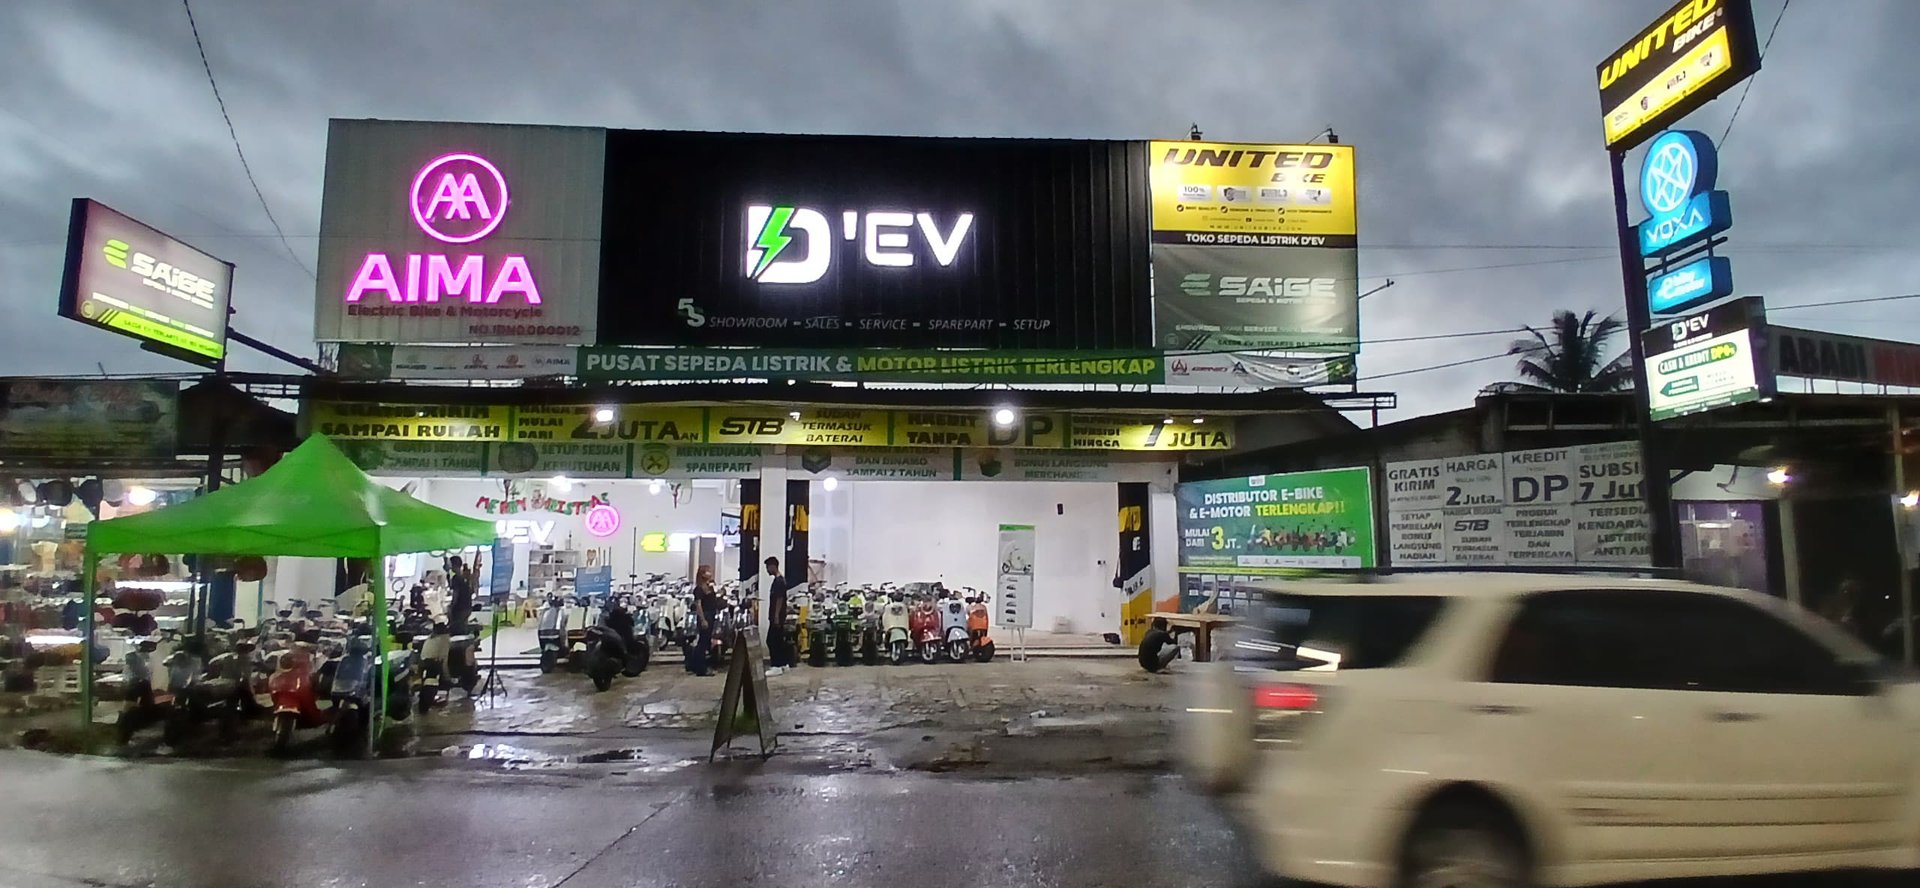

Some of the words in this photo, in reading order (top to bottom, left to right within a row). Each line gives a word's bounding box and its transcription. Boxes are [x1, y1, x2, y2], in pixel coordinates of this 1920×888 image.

[1672, 14, 1716, 54] BIKE
[1164, 148, 1333, 169] UNITED
[1271, 173, 1326, 184] BKE
[1186, 233, 1215, 244] TOKO
[1217, 234, 1259, 245] SEPEDA
[1261, 235, 1299, 246] LISTRIK
[1301, 236, 1326, 246] D'EV
[346, 253, 542, 304] AIMA
[348, 304, 403, 317] Electric
[409, 304, 440, 317] Bike
[446, 305, 456, 316] &
[461, 306, 543, 320] Motorcycle
[709, 316, 787, 328] SHOWROOM
[804, 318, 840, 329] SALES
[859, 318, 907, 330] SERVICE
[928, 319, 993, 331] SPAREPART
[1013, 319, 1051, 331] SETUP
[587, 354, 660, 371] PUSAT
[664, 355, 747, 371] SEPEDA
[752, 355, 832, 372] LISTRIK
[836, 356, 852, 372] &
[857, 356, 937, 373] MOTOR
[941, 357, 1017, 374] LISTRIK
[1022, 358, 1155, 375] TERLENGKAP
[518, 418, 563, 426] MULAI
[719, 416, 786, 436] STB
[801, 422, 872, 431] TERMASUK
[320, 422, 410, 437] SAMPAI
[417, 425, 500, 438] RUMAH
[518, 430, 553, 439] DARI
[806, 433, 863, 443] BATERAI
[907, 431, 972, 445] TANPA
[1167, 431, 1228, 447] JUTA
[582, 444, 624, 456] SESUAI
[1511, 450, 1568, 464] KREDIT
[686, 462, 753, 473] SPAREPART
[1446, 458, 1498, 473] HARGA
[1388, 465, 1440, 481] GRATIS
[1394, 479, 1436, 492] KIRIM
[1512, 474, 1569, 503] DP
[1579, 481, 1595, 501] 7
[1204, 490, 1277, 505] DISTRIBUTOR
[1281, 486, 1324, 500] E-BIKE
[1446, 486, 1462, 506] 2
[1189, 509, 1198, 519] &
[1199, 505, 1251, 519] E-MOTOR
[1255, 500, 1346, 517] TERLENGKAP!!
[1515, 509, 1558, 517] PRODUK
[1400, 512, 1431, 521] SETIAP
[1391, 522, 1442, 531] PEMBELIAN
[1453, 519, 1490, 531] STB
[1505, 519, 1571, 528] TERLENGKAP
[1577, 519, 1649, 530] KENDARA
[1184, 528, 1210, 538] MULAI
[1211, 525, 1225, 550] 3
[1393, 542, 1442, 550] LANGSUNG
[1527, 540, 1551, 548] DAN
[1399, 552, 1436, 560] HADIAH
[1508, 550, 1574, 559] TERPERCAYA
